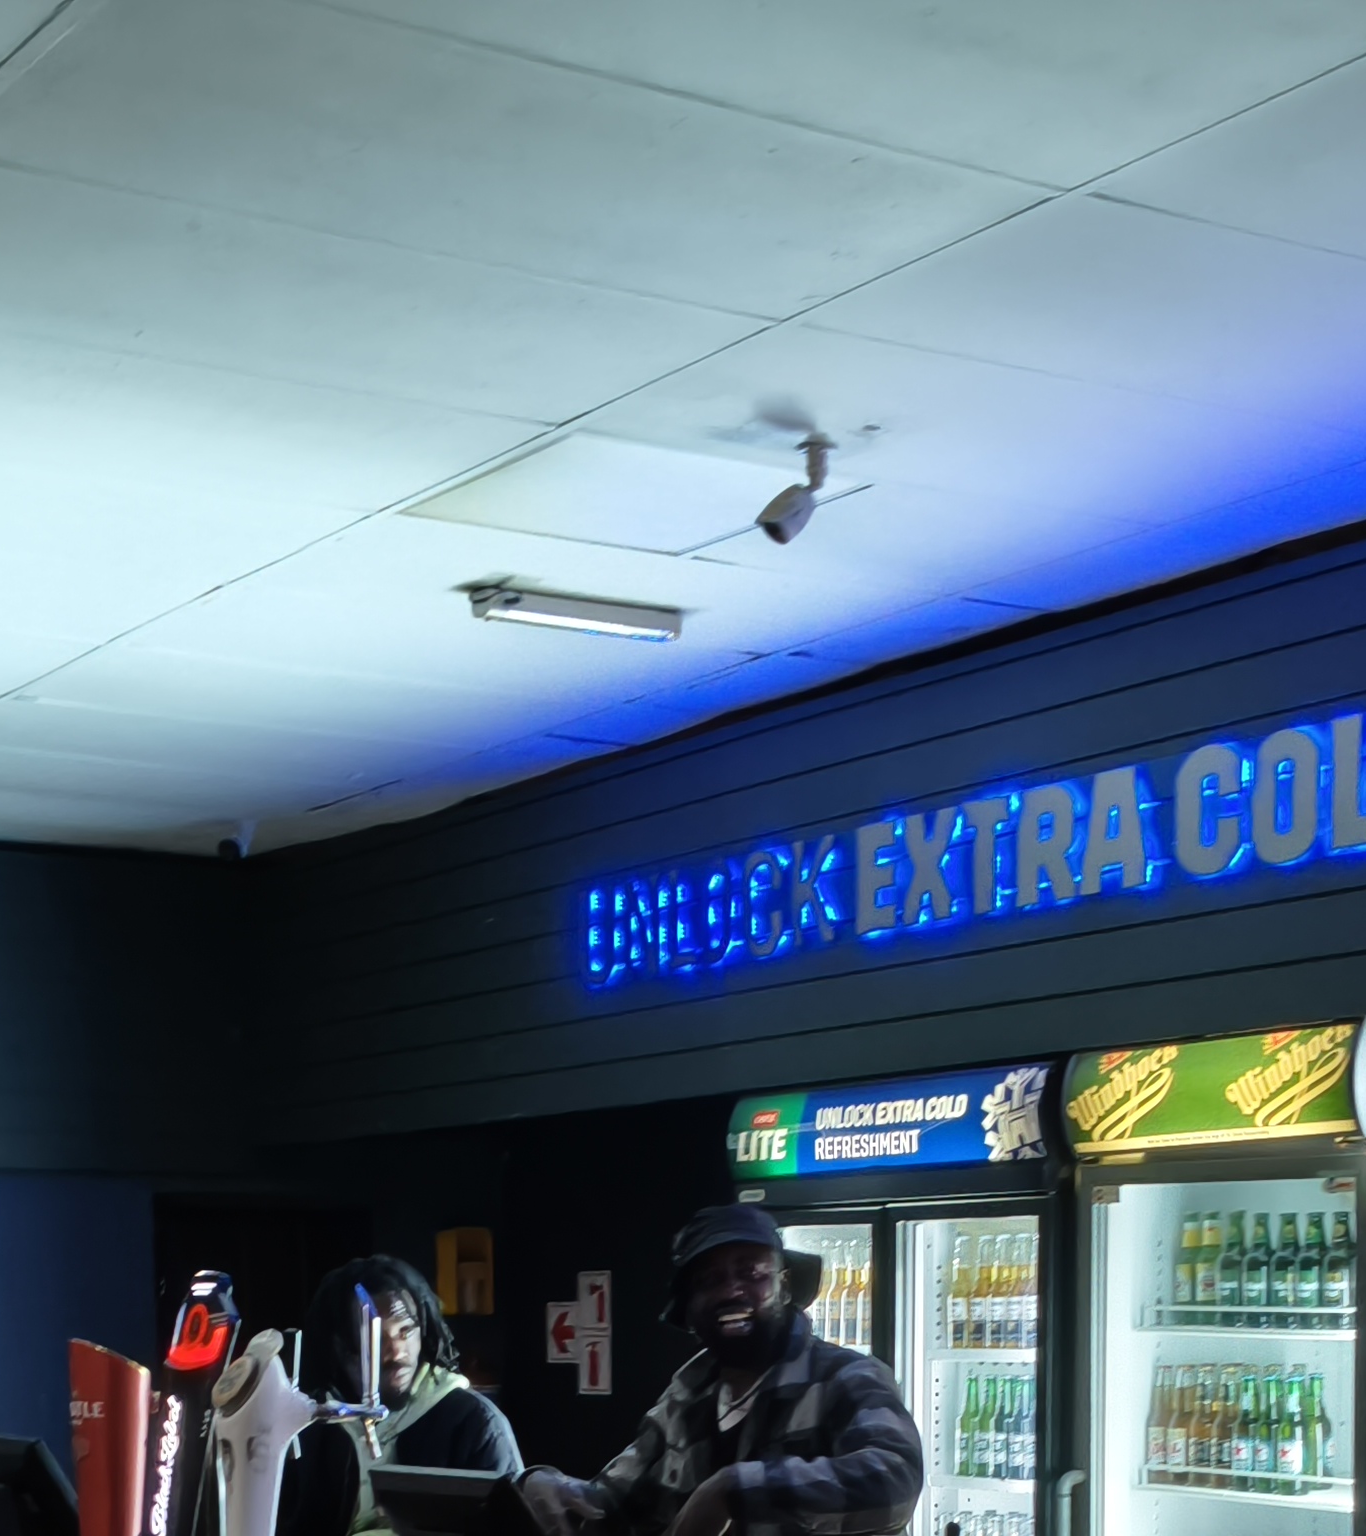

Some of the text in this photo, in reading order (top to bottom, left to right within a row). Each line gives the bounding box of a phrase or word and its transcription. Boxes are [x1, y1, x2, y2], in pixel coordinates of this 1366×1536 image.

[585, 834, 835, 985] UNLOCK
[854, 766, 1148, 936] EXTRA
[815, 1093, 969, 1131] UNLOCK EXTRA COLD
[736, 1127, 788, 1163] LITE
[814, 1128, 922, 1161] REFRESHMENT
